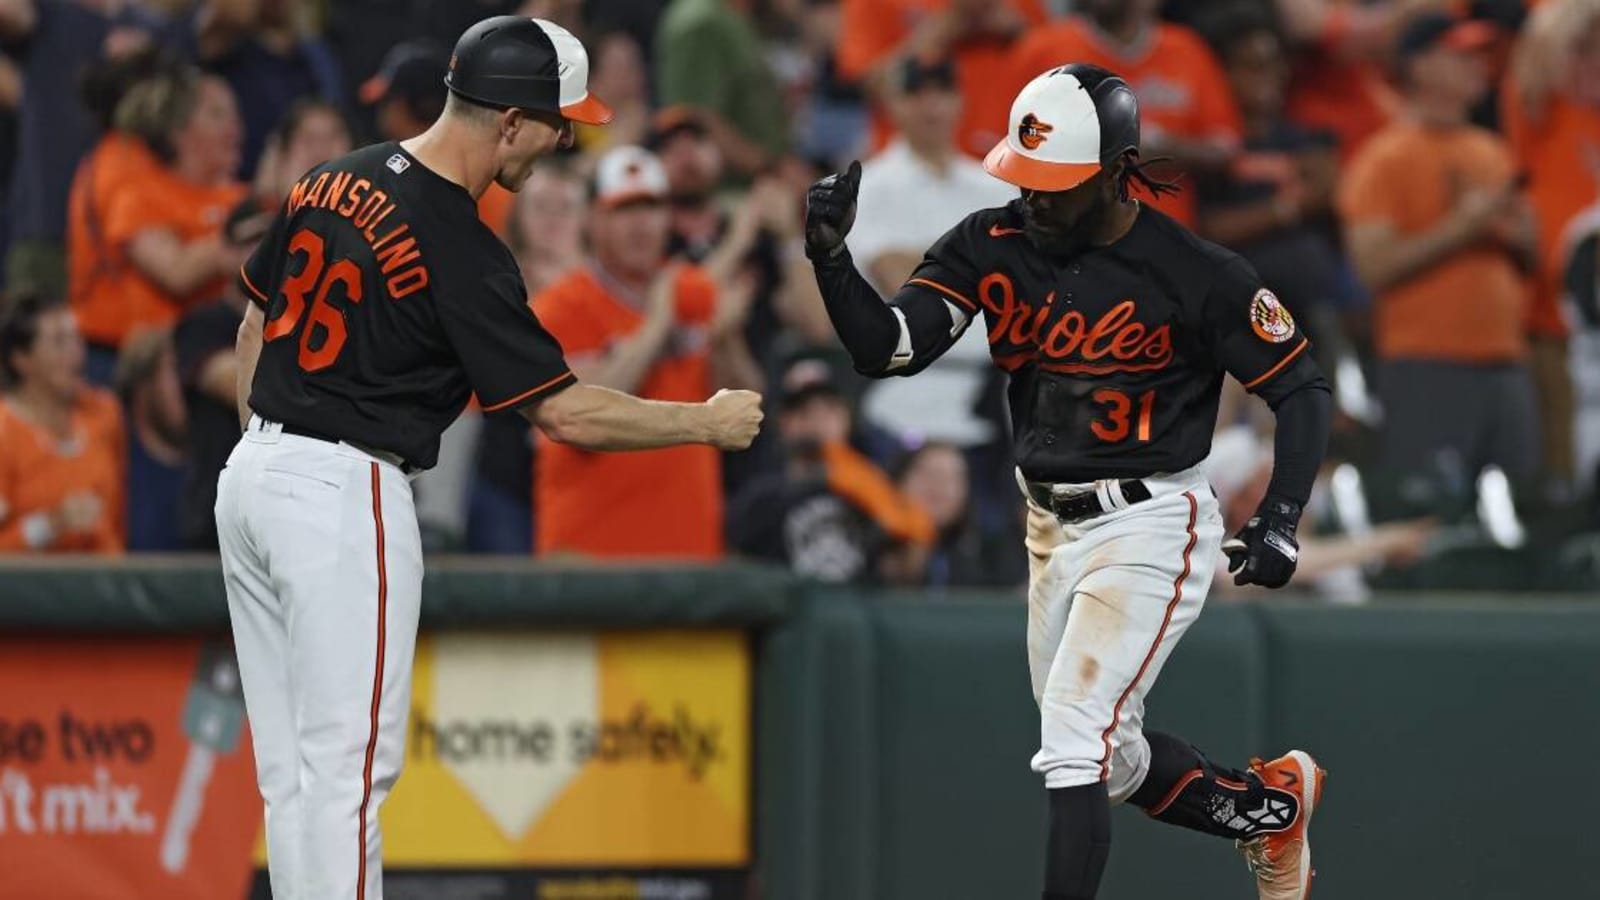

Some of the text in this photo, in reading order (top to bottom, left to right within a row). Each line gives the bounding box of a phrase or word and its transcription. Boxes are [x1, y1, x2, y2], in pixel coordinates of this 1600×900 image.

[287, 171, 428, 299] MANSOLINO
[263, 228, 362, 372] 36
[978, 273, 1173, 362] Orioles
[1090, 388, 1155, 442] 31
[60, 708, 153, 766] two
[410, 700, 727, 782] home safely.
[43, 767, 154, 834] mix.
